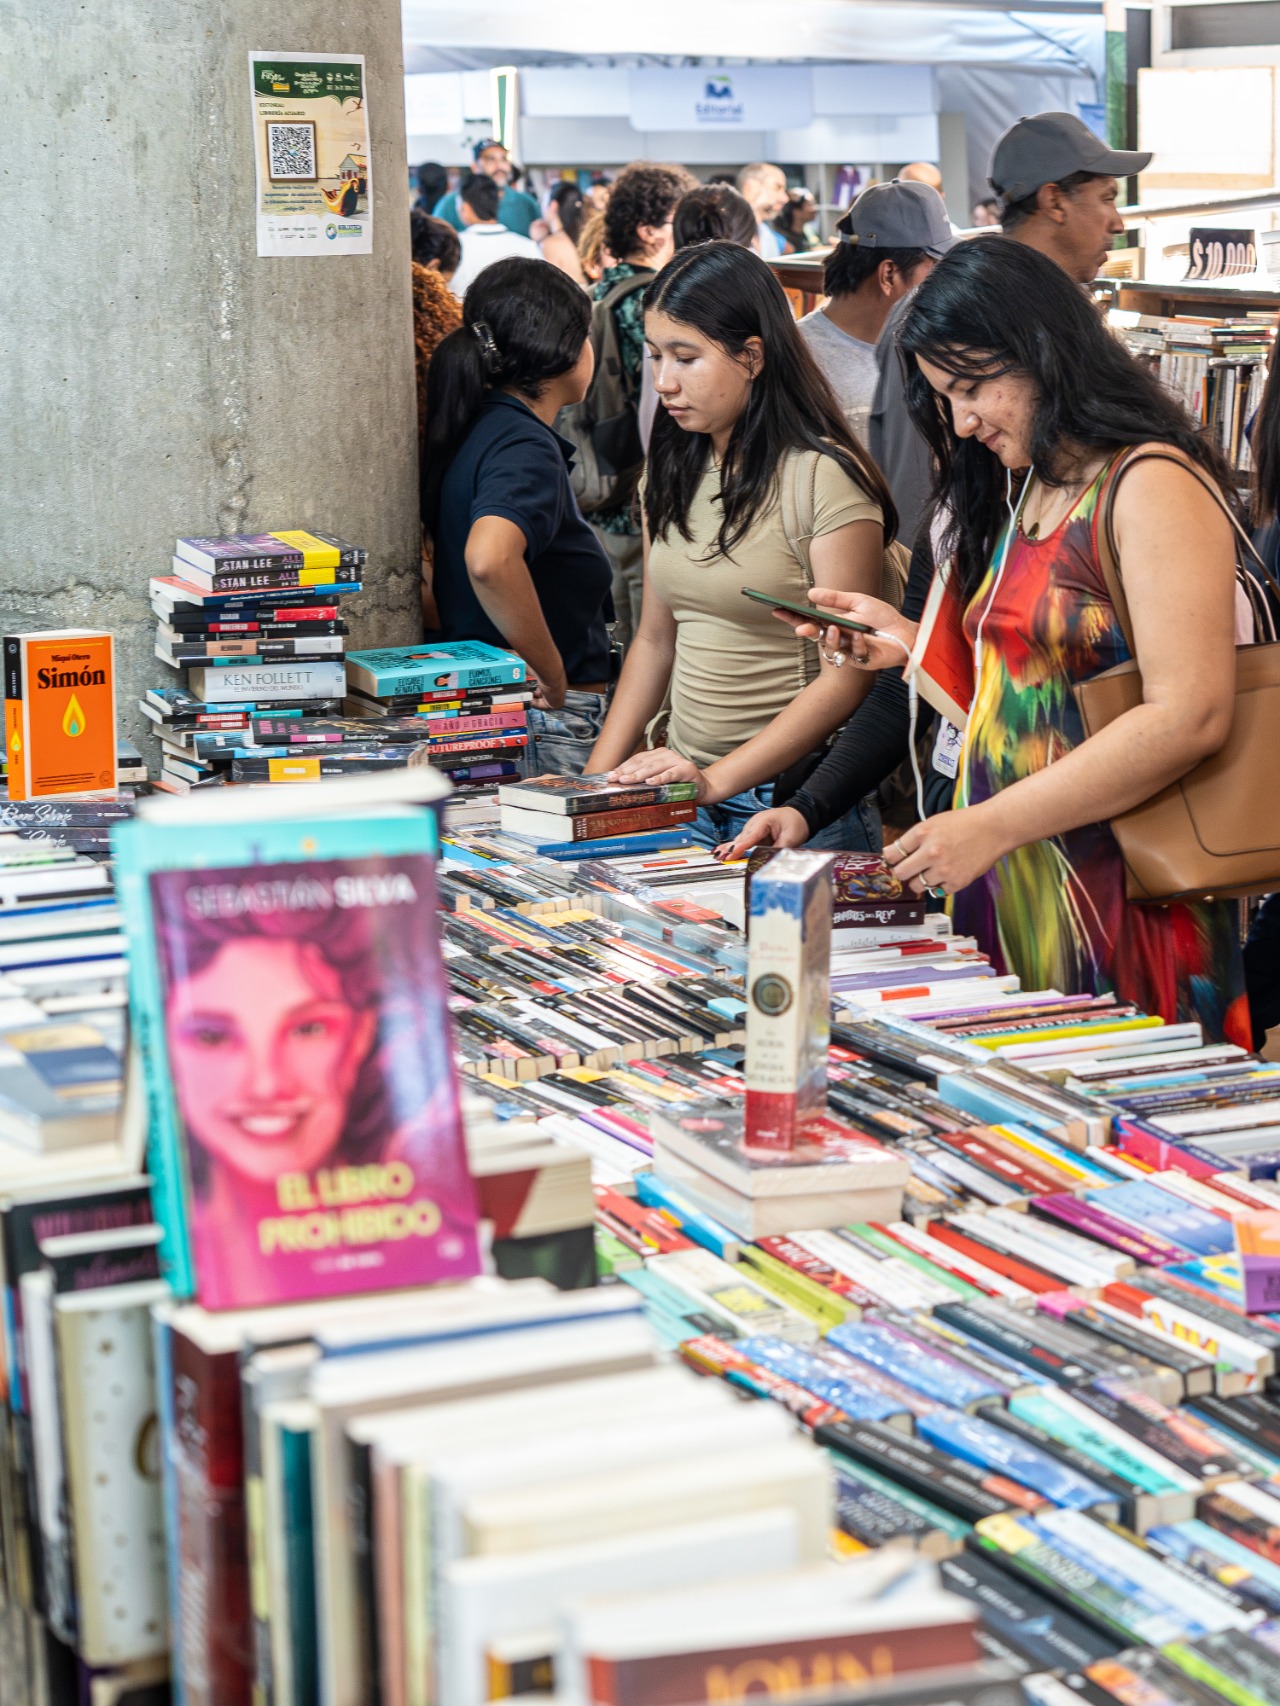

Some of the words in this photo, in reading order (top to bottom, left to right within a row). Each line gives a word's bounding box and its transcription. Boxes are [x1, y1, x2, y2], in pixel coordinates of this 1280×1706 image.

[696, 103, 742, 115] Editorial
[222, 560, 249, 571] STAN
[253, 557, 273, 569] LEE
[219, 577, 247, 589] STAN
[250, 574, 270, 586] LEE
[51, 653, 71, 664] Miqui
[72, 652, 91, 662] Otero
[37, 666, 106, 690] Simón
[223, 673, 252, 687] KEN
[256, 670, 314, 686] FOLLETT
[468, 667, 492, 679] FUIMOS
[468, 676, 503, 687] CANCIONES
[443, 717, 460, 731] AÑO
[471, 716, 504, 728] GRACIA
[427, 738, 497, 754] FUTUREPROOF
[186, 875, 331, 918] SEBASTIÁN
[333, 873, 417, 908] SILVA
[875, 908, 896, 924] REY
[277, 1173, 316, 1211] EL
[320, 1160, 415, 1206] LIBRO
[258, 1200, 442, 1256] PROHIBIDO
[704, 1643, 895, 1702] JOHN
